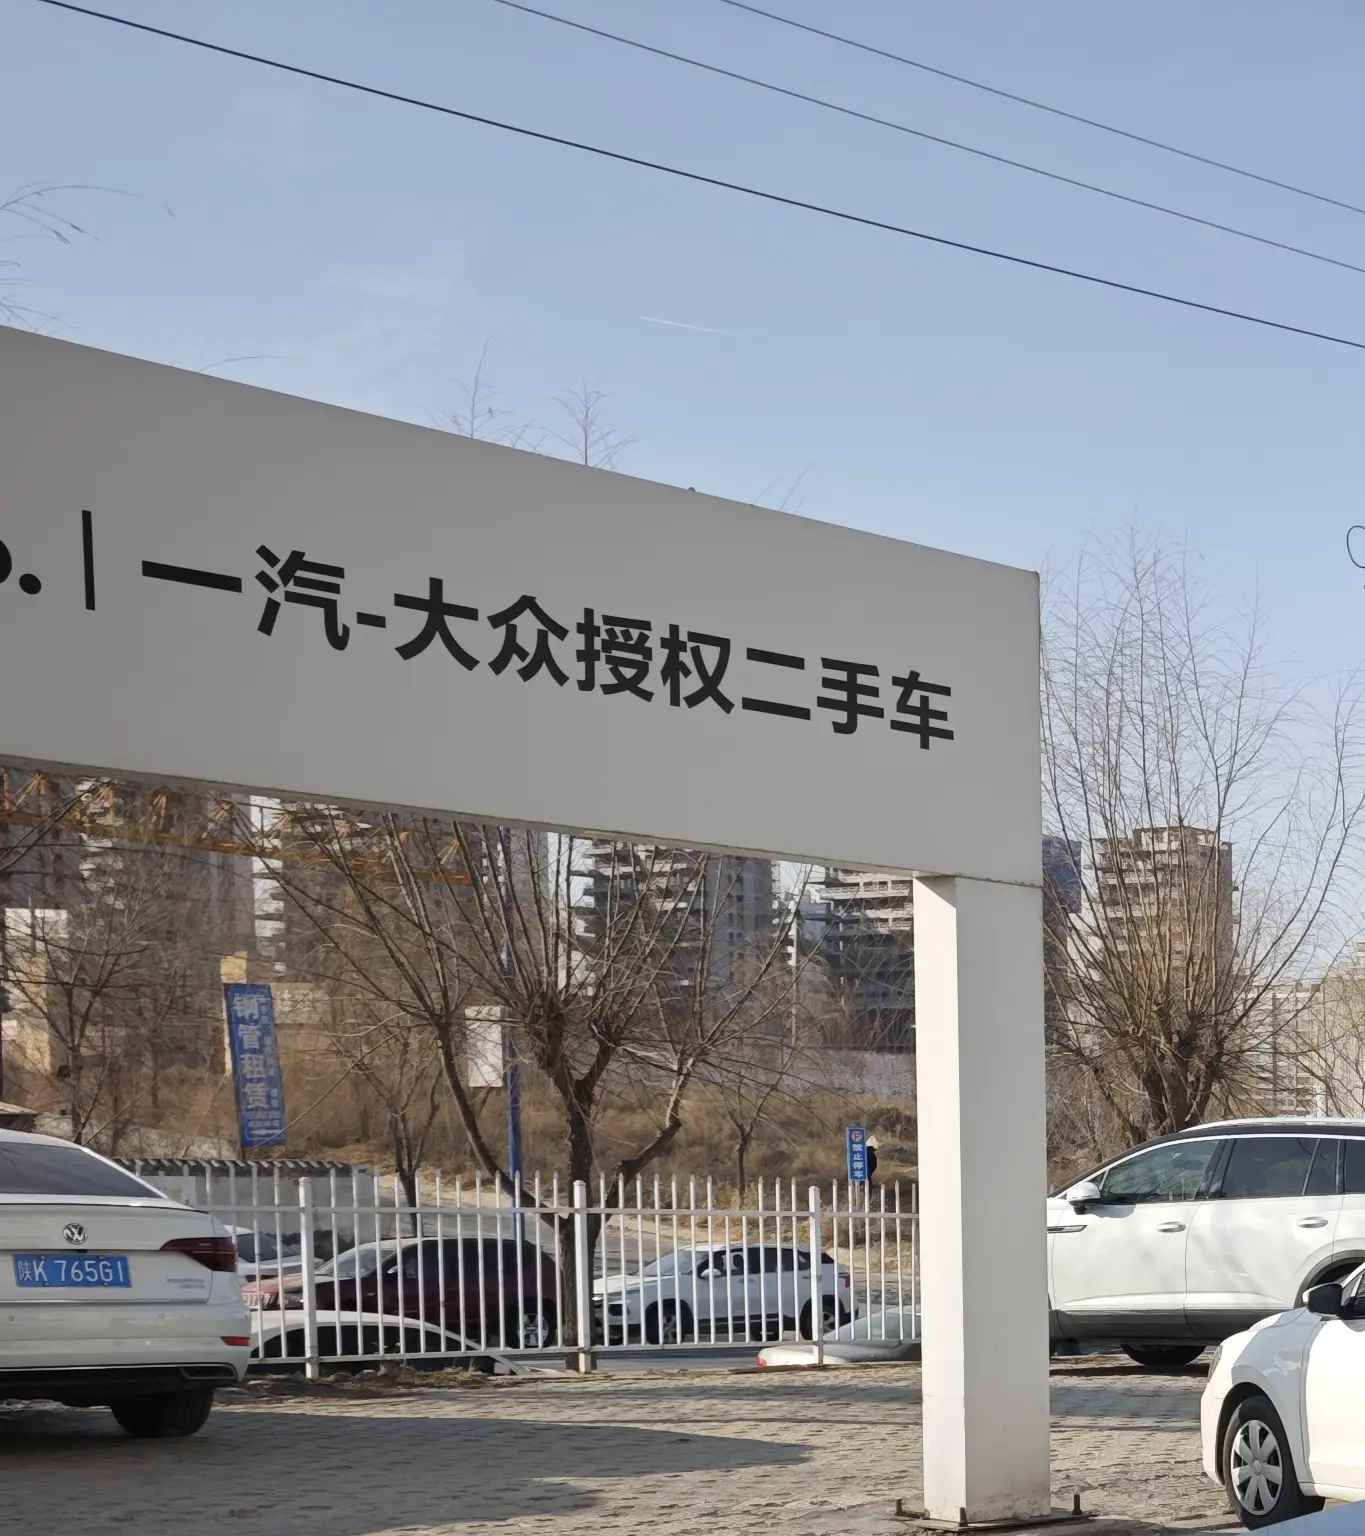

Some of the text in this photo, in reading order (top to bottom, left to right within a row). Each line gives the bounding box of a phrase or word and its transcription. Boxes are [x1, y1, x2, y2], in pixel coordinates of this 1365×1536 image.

[141, 544, 956, 751] 一汽-大众授权二手车
